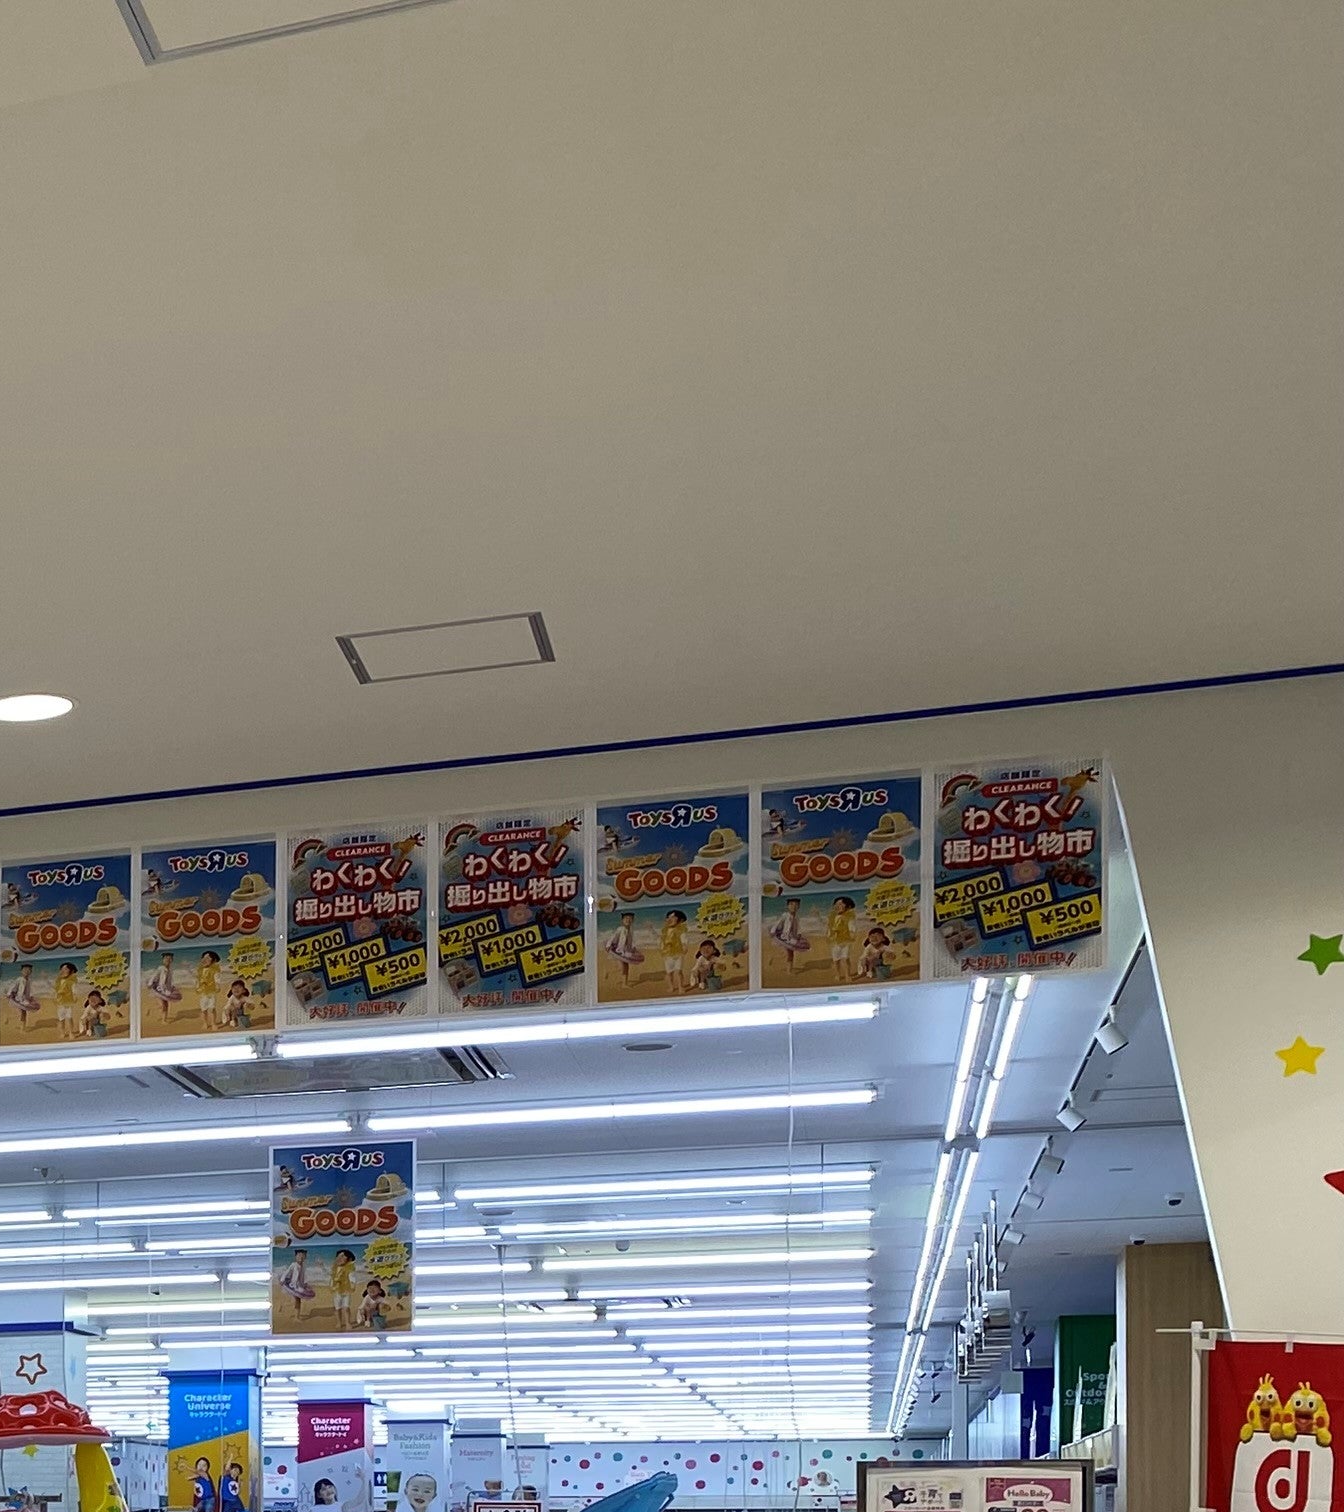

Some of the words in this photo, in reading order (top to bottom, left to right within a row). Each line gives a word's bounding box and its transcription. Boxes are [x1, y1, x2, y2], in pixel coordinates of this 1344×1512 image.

[992, 781, 1052, 794] CLEARANCE
[488, 830, 541, 842] CLEARANCE
[943, 829, 1095, 866] 掘り出し物市
[335, 846, 386, 857] CLEARANCE
[615, 861, 733, 900] GOODS
[780, 847, 905, 888] GOODS
[446, 875, 579, 910] 掘り出し物市
[935, 876, 1002, 905] ¥2,000
[983, 888, 1046, 916] ¥1,000
[294, 889, 421, 923] 掘り出し物市
[1039, 900, 1093, 924] ¥500
[16, 917, 117, 952] GOODS
[157, 905, 261, 942] GOODS
[439, 918, 498, 946] ¥2,000
[288, 932, 344, 960] ¥2,000
[328, 942, 381, 968] ¥1,000
[481, 929, 536, 956] ¥1,000
[531, 940, 577, 964] ¥500
[376, 953, 420, 976] ¥500
[290, 1205, 399, 1240] GOODS
[184, 1394, 232, 1402] Character
[187, 1402, 231, 1410] Universe
[311, 1417, 351, 1425] Character
[1030, 1490, 1051, 1500] Baby
